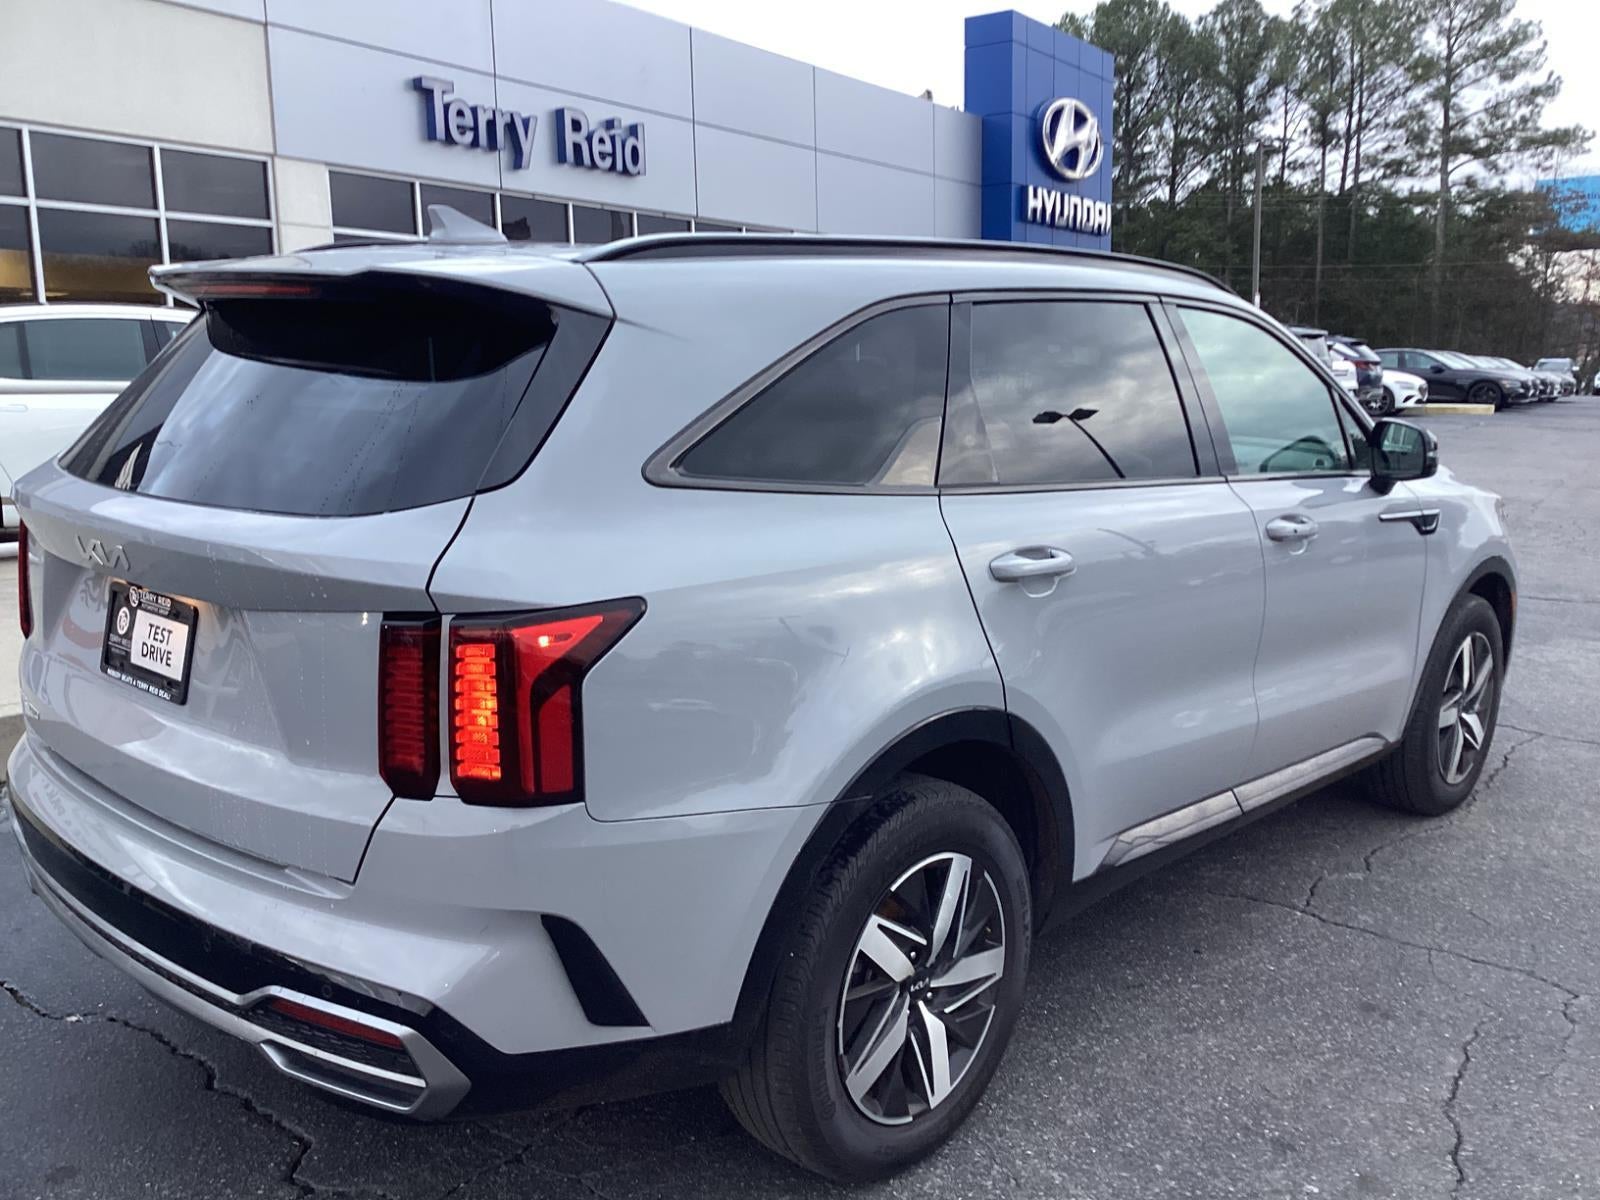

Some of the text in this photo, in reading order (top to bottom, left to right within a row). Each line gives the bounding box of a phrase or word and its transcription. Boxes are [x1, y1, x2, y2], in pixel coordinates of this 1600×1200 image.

[412, 75, 647, 177] Terry Reid
[1028, 185, 1111, 234] HYUNDAI
[139, 589, 171, 607] TERRY REID
[148, 623, 173, 645] TEST
[141, 643, 173, 668] DRIVE
